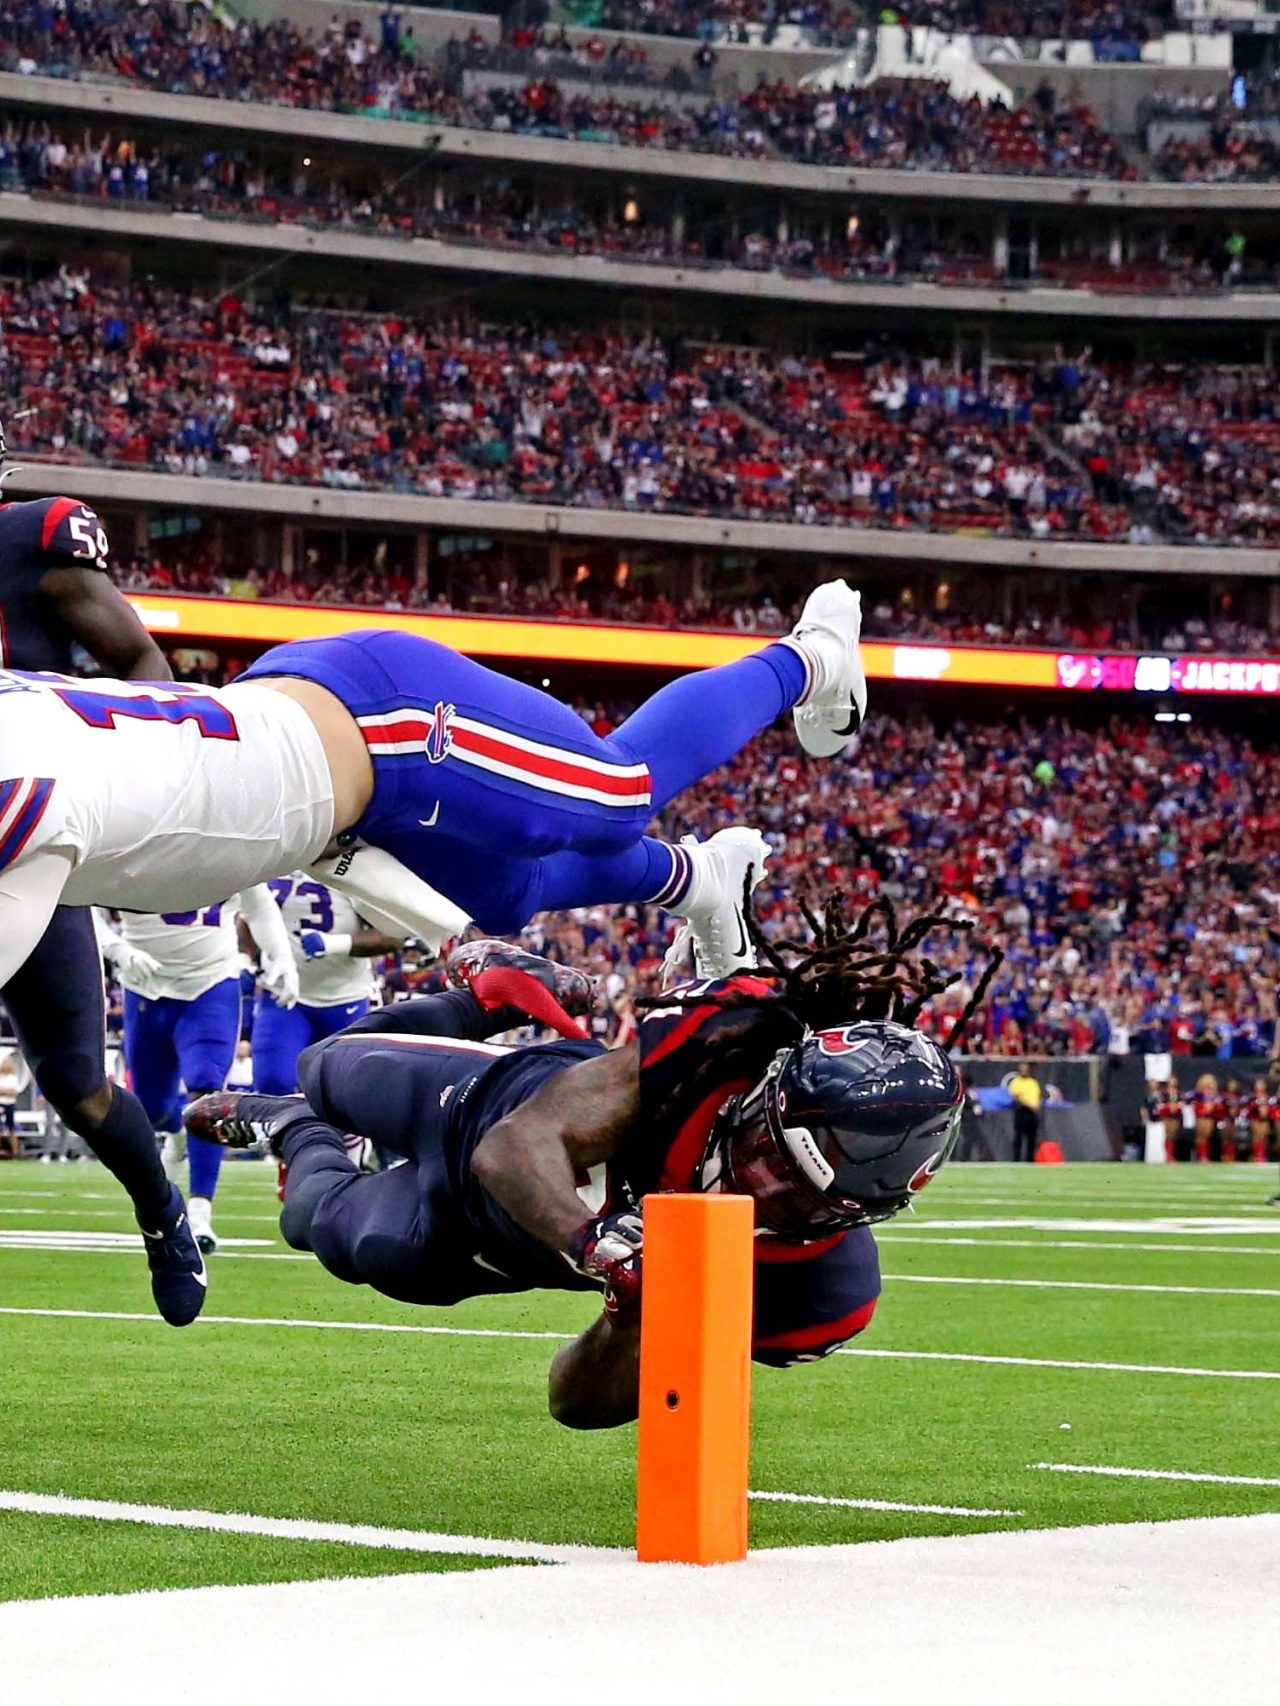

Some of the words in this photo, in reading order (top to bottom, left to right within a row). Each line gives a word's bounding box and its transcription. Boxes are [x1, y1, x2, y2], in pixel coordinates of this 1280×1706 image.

[68, 516, 109, 569] 59
[1181, 661, 1280, 692] JACKPO
[801, 1136, 827, 1176] TEXANS
